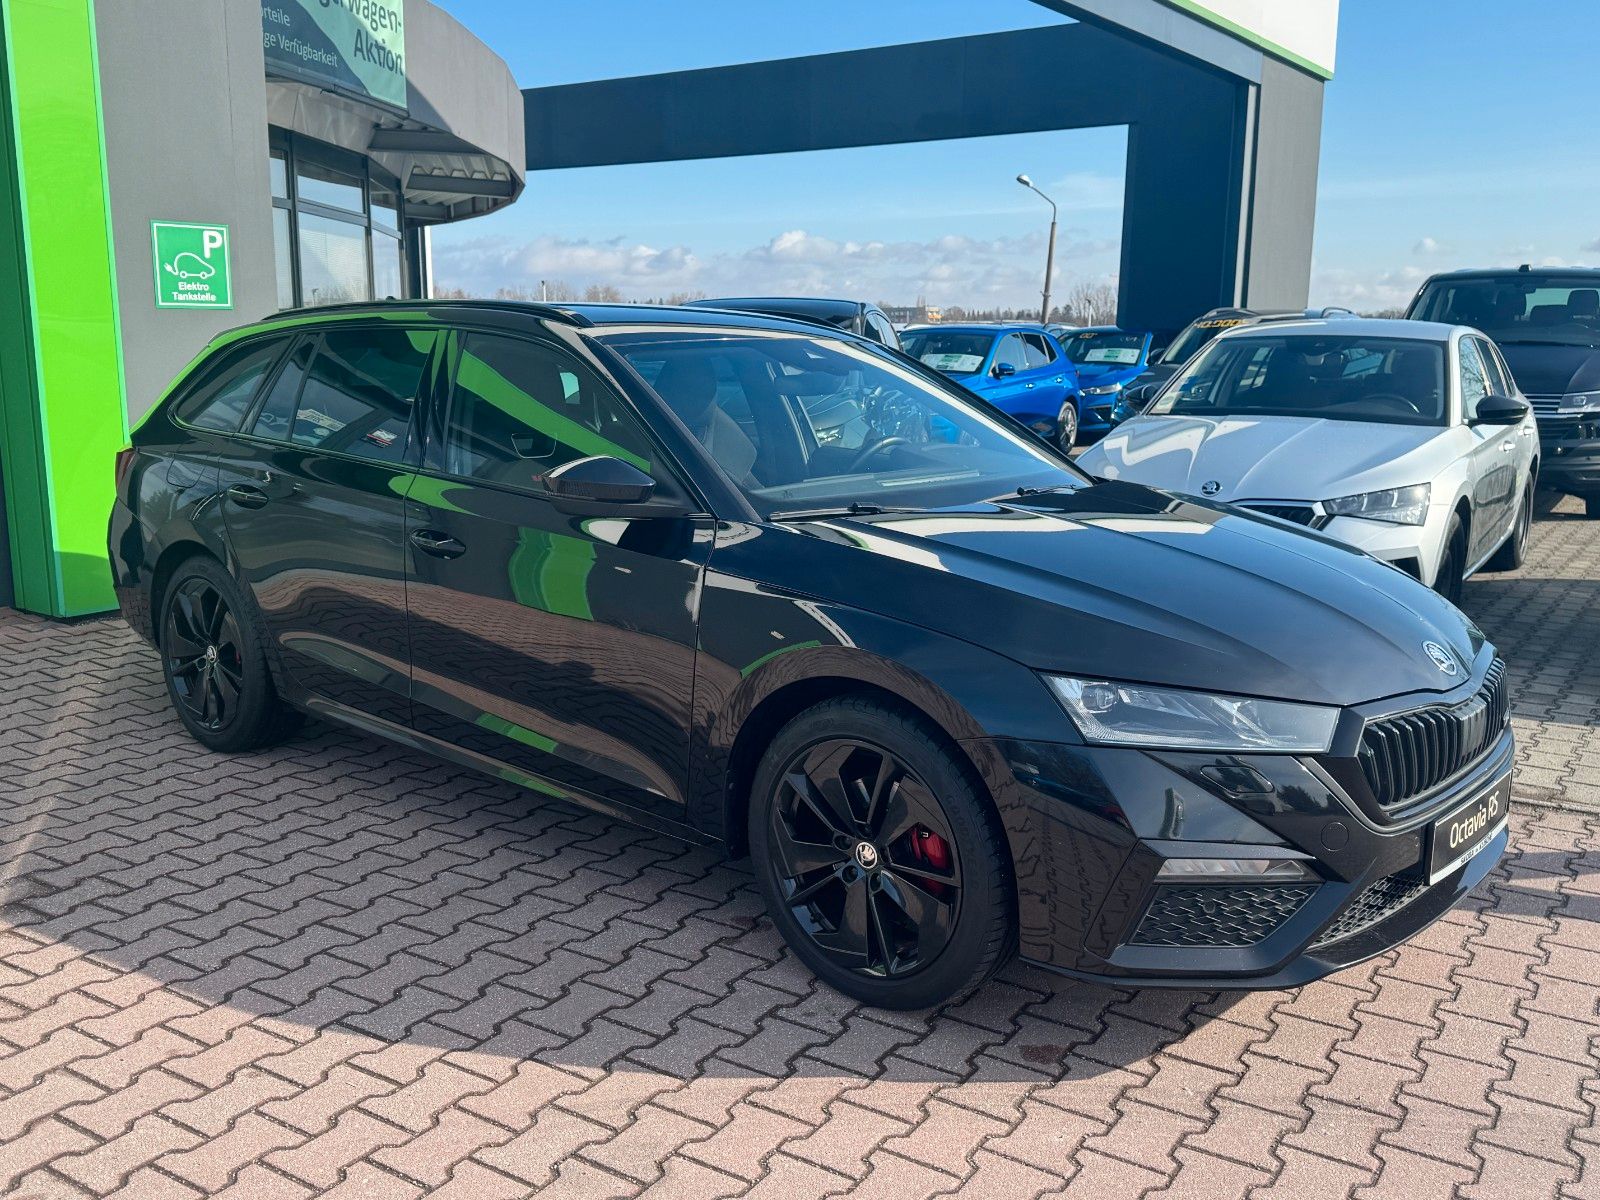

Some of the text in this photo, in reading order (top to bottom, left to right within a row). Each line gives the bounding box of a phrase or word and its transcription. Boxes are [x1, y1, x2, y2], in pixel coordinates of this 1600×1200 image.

[319, 0, 402, 34] wagen-
[277, 33, 338, 67] Verfügbarkeit
[353, 28, 404, 76] Aktion
[202, 230, 223, 259] P
[171, 292, 217, 302] Tankstelle
[178, 281, 210, 291] Elektro
[1450, 804, 1487, 848] Octavia
[1487, 790, 1500, 820] RS
